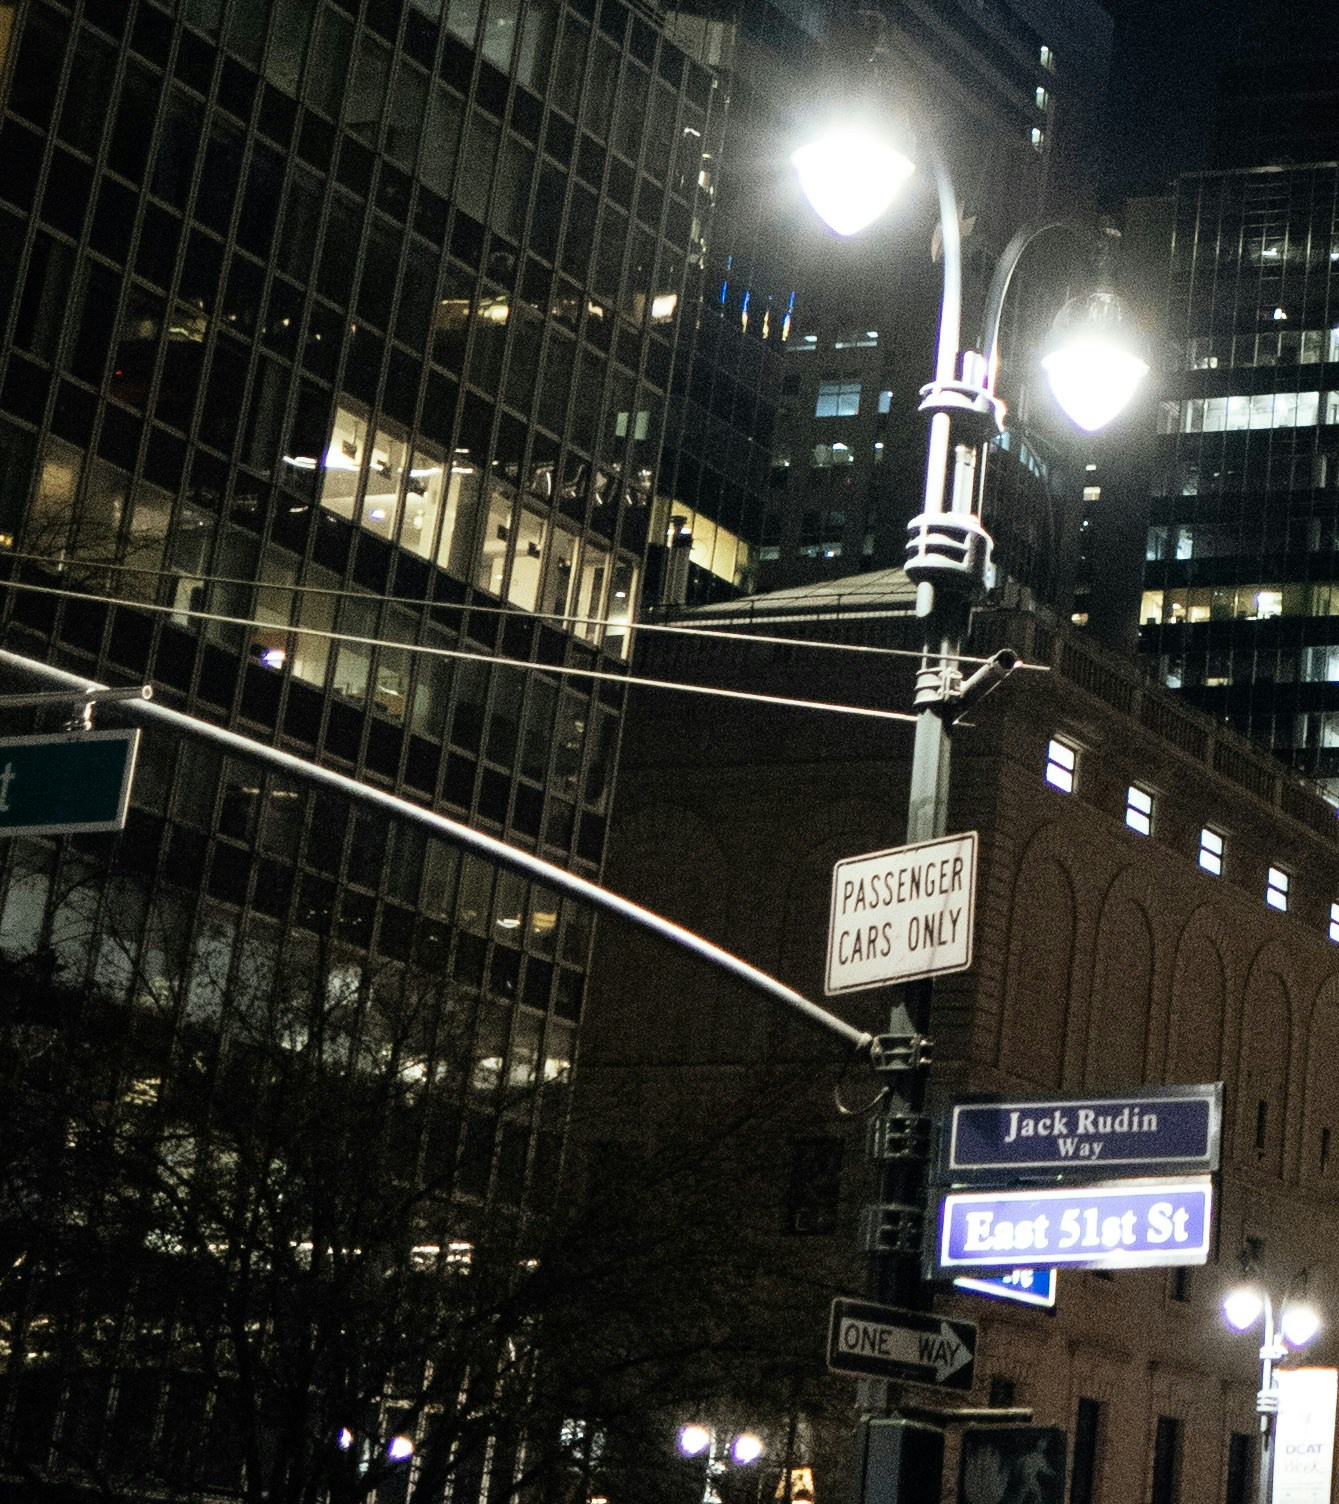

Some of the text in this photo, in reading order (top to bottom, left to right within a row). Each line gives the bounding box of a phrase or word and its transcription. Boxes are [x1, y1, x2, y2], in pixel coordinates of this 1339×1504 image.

[842, 856, 964, 915] PASSENGER
[838, 906, 962, 966] CARS ONLY
[1004, 1106, 1158, 1143] Jack Rudin
[1058, 1137, 1104, 1161] Way
[963, 1201, 1190, 1252] East 51st St
[844, 1322, 961, 1368] ONE WAY
[1285, 1443, 1324, 1455] DCAT
